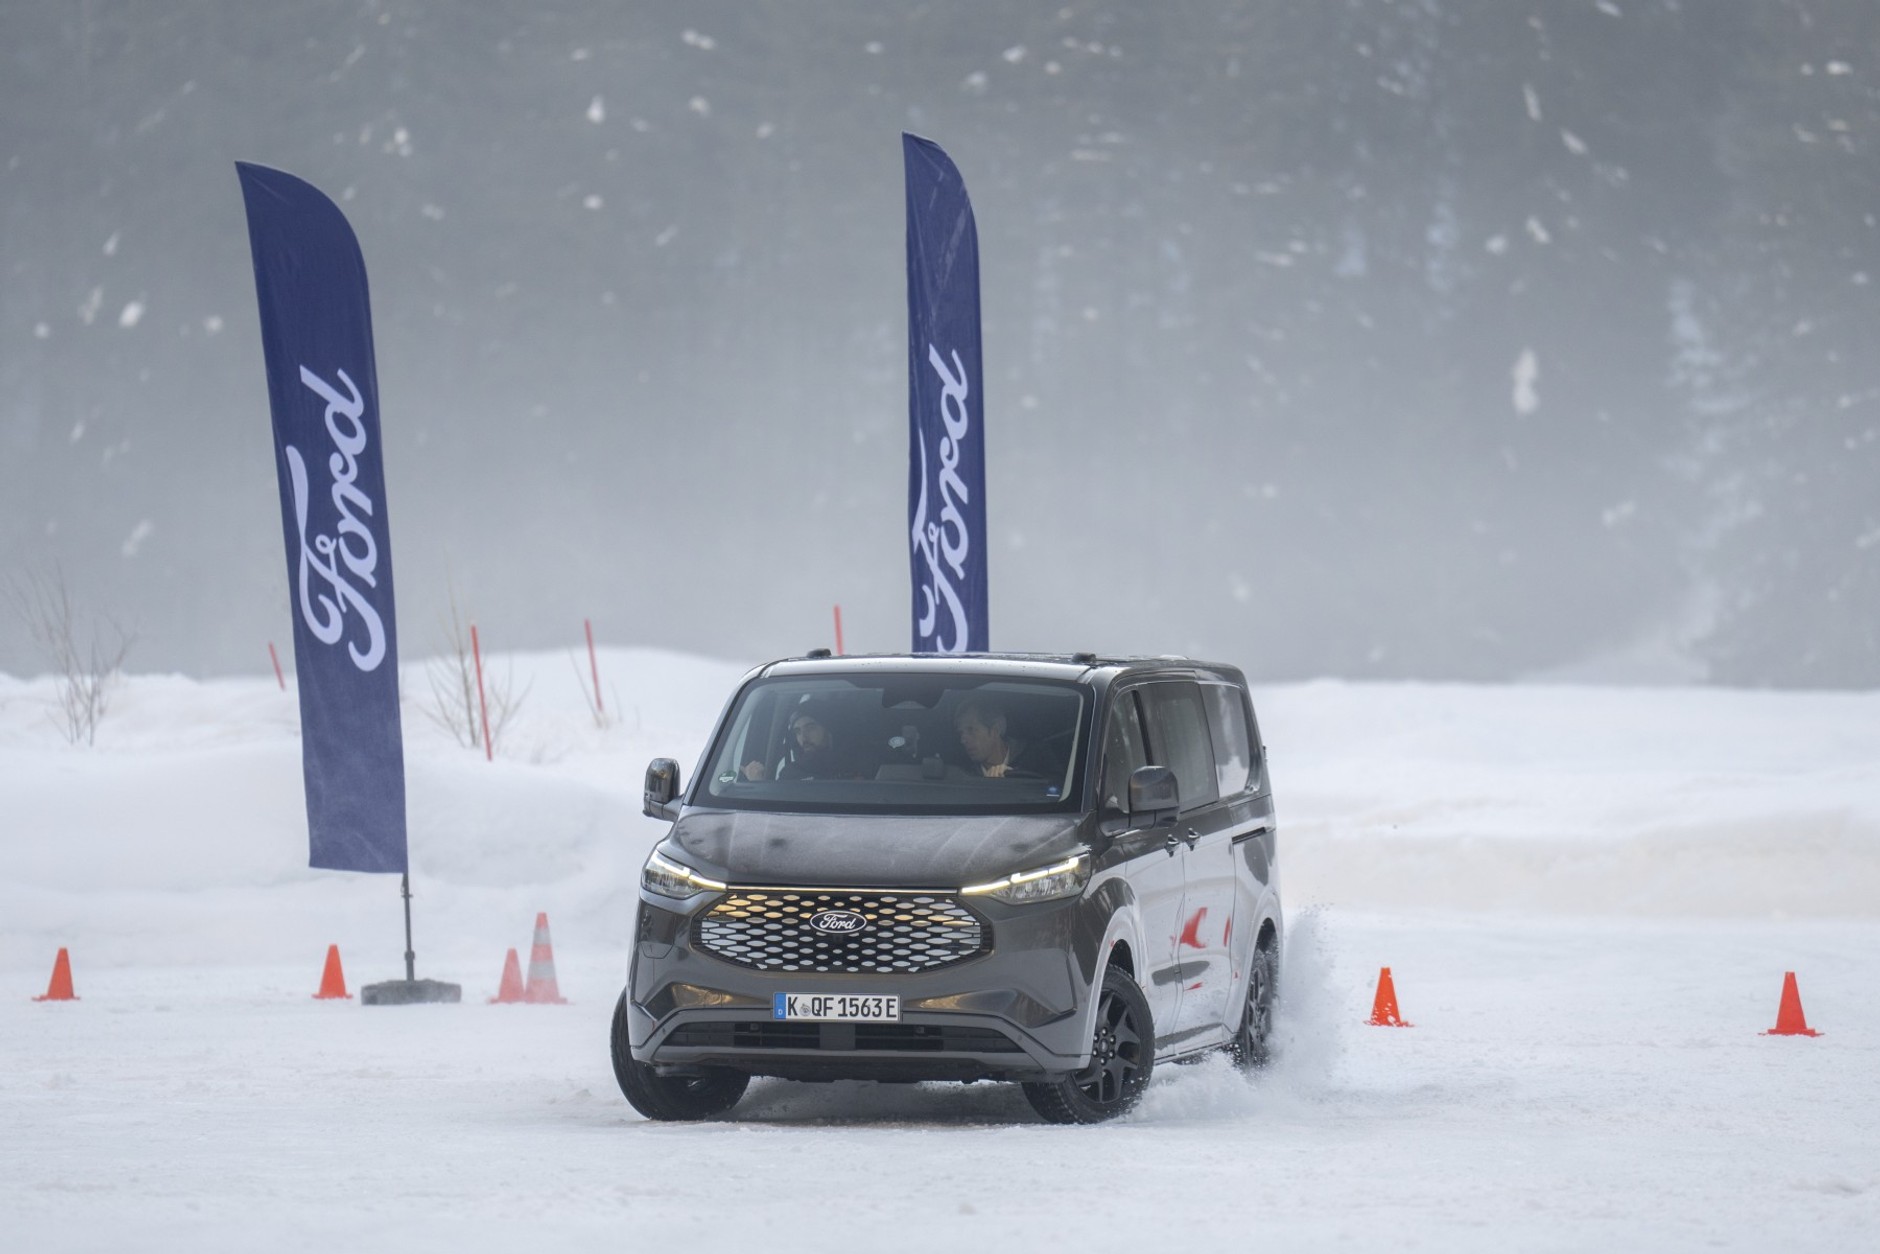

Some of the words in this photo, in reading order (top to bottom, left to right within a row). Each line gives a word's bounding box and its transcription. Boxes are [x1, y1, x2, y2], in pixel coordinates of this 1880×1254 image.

[286, 365, 386, 672] Ford
[912, 343, 968, 652] Ford
[819, 913, 857, 929] Ford
[787, 996, 798, 1016] K
